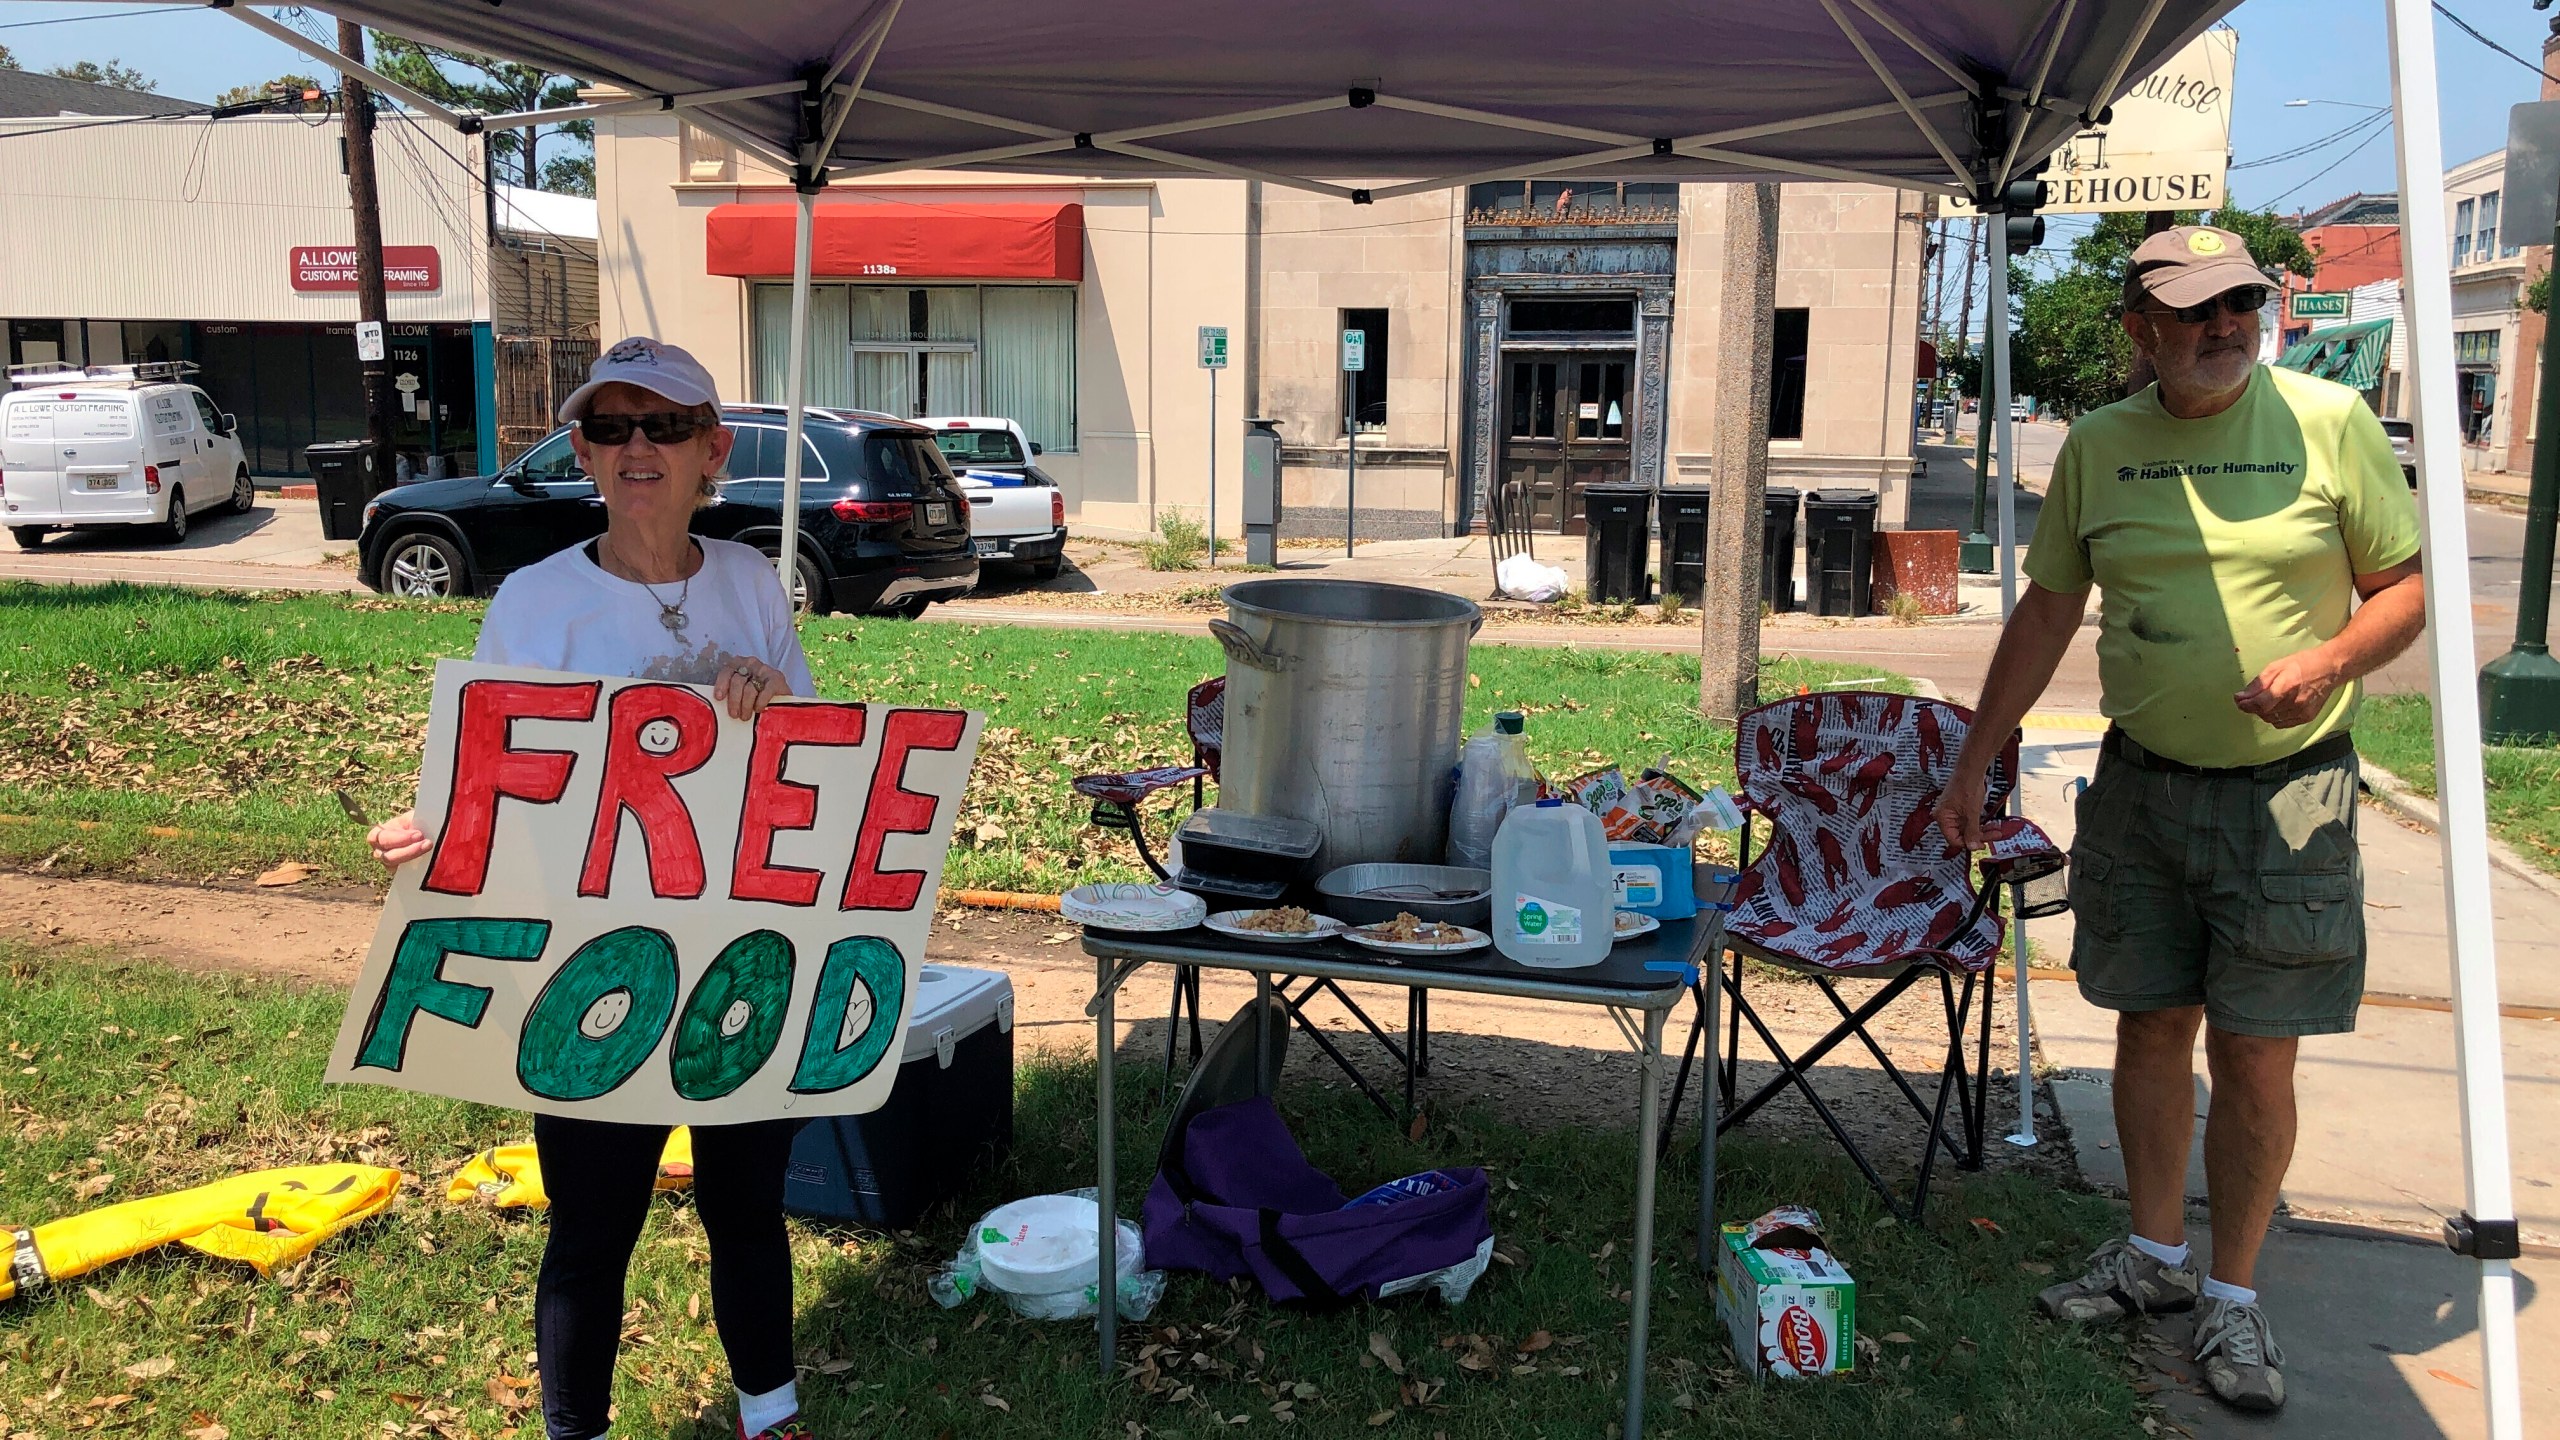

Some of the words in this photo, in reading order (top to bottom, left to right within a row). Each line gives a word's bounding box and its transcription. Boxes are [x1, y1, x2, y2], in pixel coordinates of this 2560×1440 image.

[863, 264, 897, 275] 1138a
[300, 270, 340, 281] CUSTOM
[383, 270, 429, 281] FRAMING
[206, 325, 238, 334] custom
[394, 350, 418, 361] 1126
[29, 404, 51, 413] LOWE
[53, 403, 87, 413] CUSTOM
[88, 403, 125, 413] FRAMING
[2139, 463, 2194, 481] Habitat
[2196, 463, 2219, 475] for
[2222, 461, 2296, 475] Humanity
[421, 680, 968, 911] FREE
[1523, 913, 1543, 922] Spring
[1523, 920, 1543, 928] Water
[352, 917, 907, 1102] FOOD
[1788, 1295, 1795, 1305] 27
[1789, 1309, 1821, 1376] BOOST
